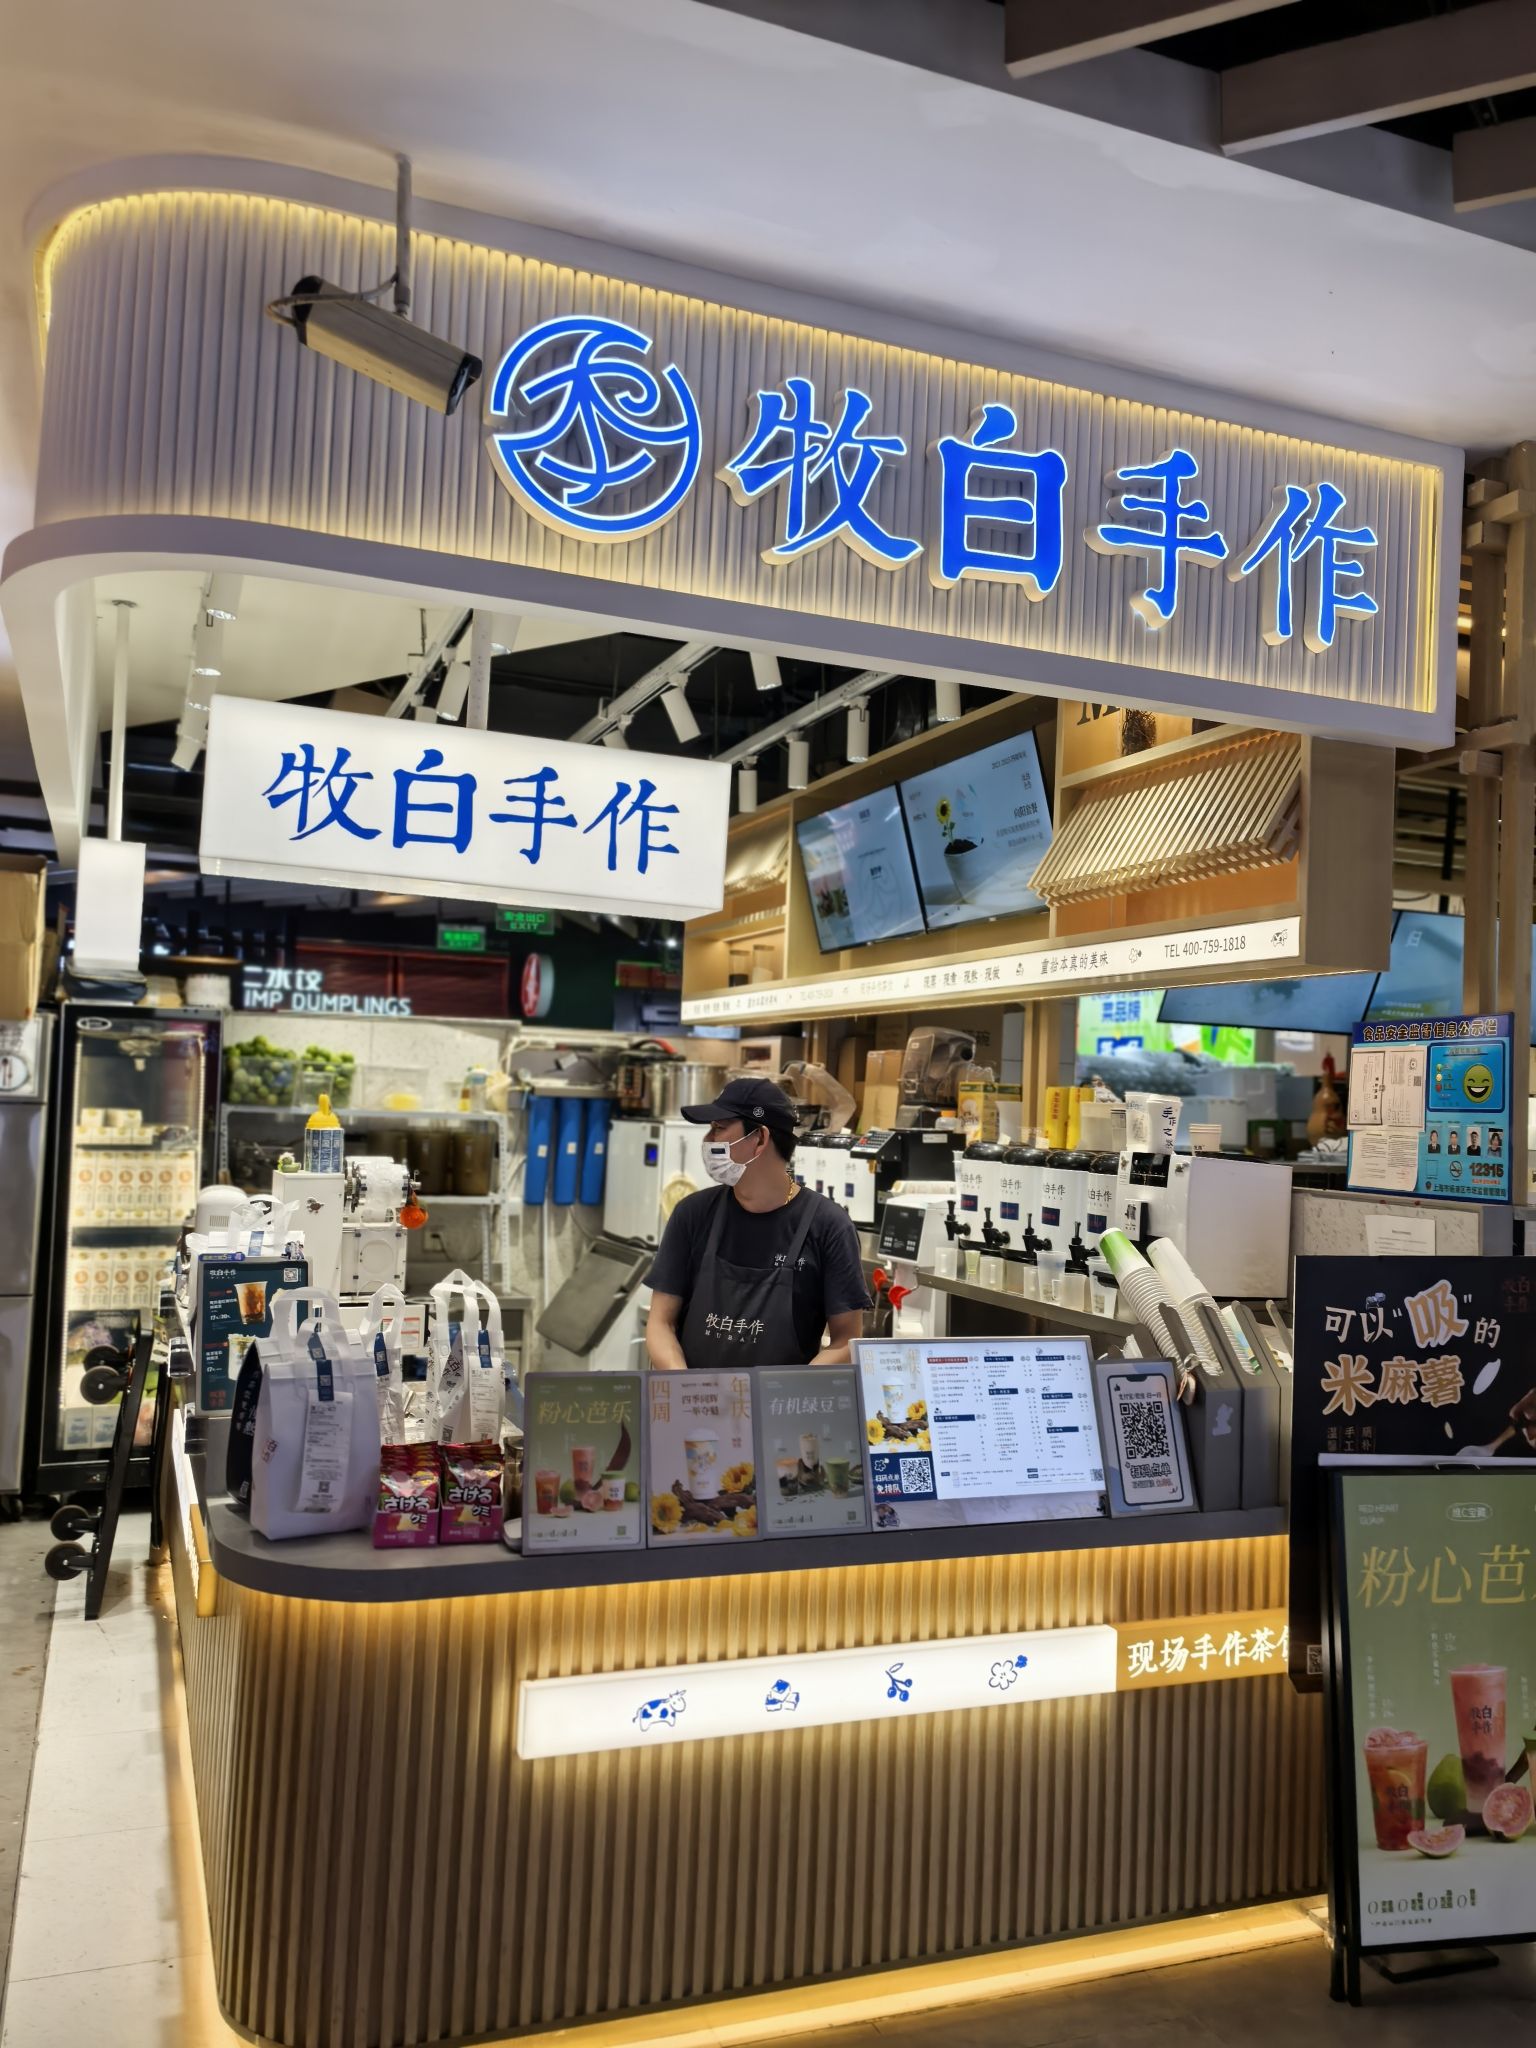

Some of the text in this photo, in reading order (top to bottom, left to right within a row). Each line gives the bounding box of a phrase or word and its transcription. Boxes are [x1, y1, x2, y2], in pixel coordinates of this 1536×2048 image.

[727, 376, 1379, 649] 牧白手作
[262, 743, 680, 875] 牧白手作
[1164, 935, 1246, 958] TEL 400-759-1818
[291, 992, 411, 1016] DUMPLINGS
[1363, 1018, 1498, 1041] 食品安全监督信息公示栏
[959, 1172, 983, 1187] 白手作
[1469, 1162, 1504, 1178] 12315
[1000, 1175, 1022, 1190] 白手作
[1042, 1181, 1066, 1196] 白手作
[704, 1312, 765, 1336] 牧白手作
[1320, 1354, 1465, 1416] 米麻薯
[537, 1400, 632, 1425] 粉心芭乐
[768, 1396, 835, 1416] 有机绿豆
[1130, 1462, 1172, 1480] 扫码点单
[383, 1496, 430, 1513] さける
[449, 1486, 493, 1503] さける
[409, 1512, 428, 1526] グミ
[472, 1504, 491, 1518] グミ
[1356, 1543, 1536, 1609] 粉心芭
